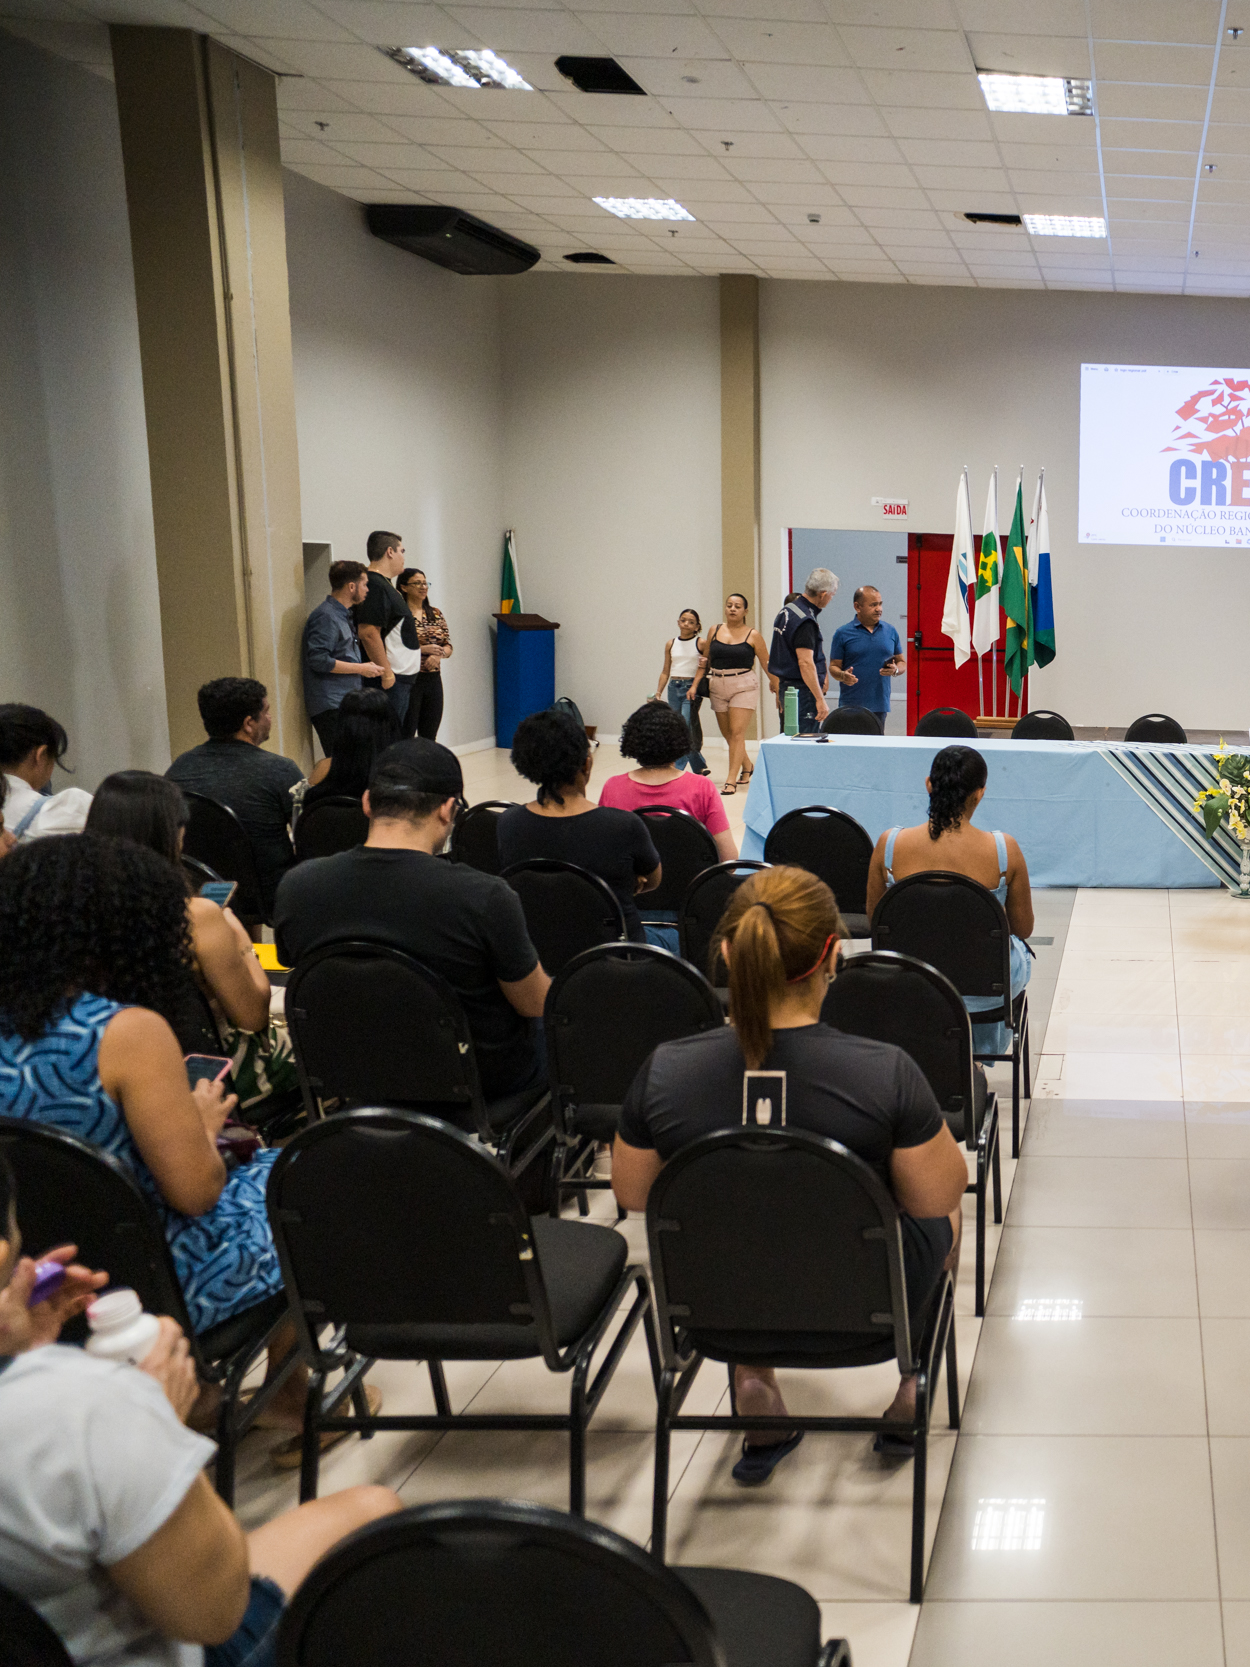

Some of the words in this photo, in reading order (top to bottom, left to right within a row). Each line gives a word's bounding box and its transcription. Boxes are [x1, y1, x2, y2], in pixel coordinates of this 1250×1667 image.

[883, 504, 907, 515] SAÍDA
[1121, 508, 1216, 521] COORDENAÇÃO
[1154, 524, 1173, 534] DO
[1176, 523, 1226, 536] NÚCLEO
